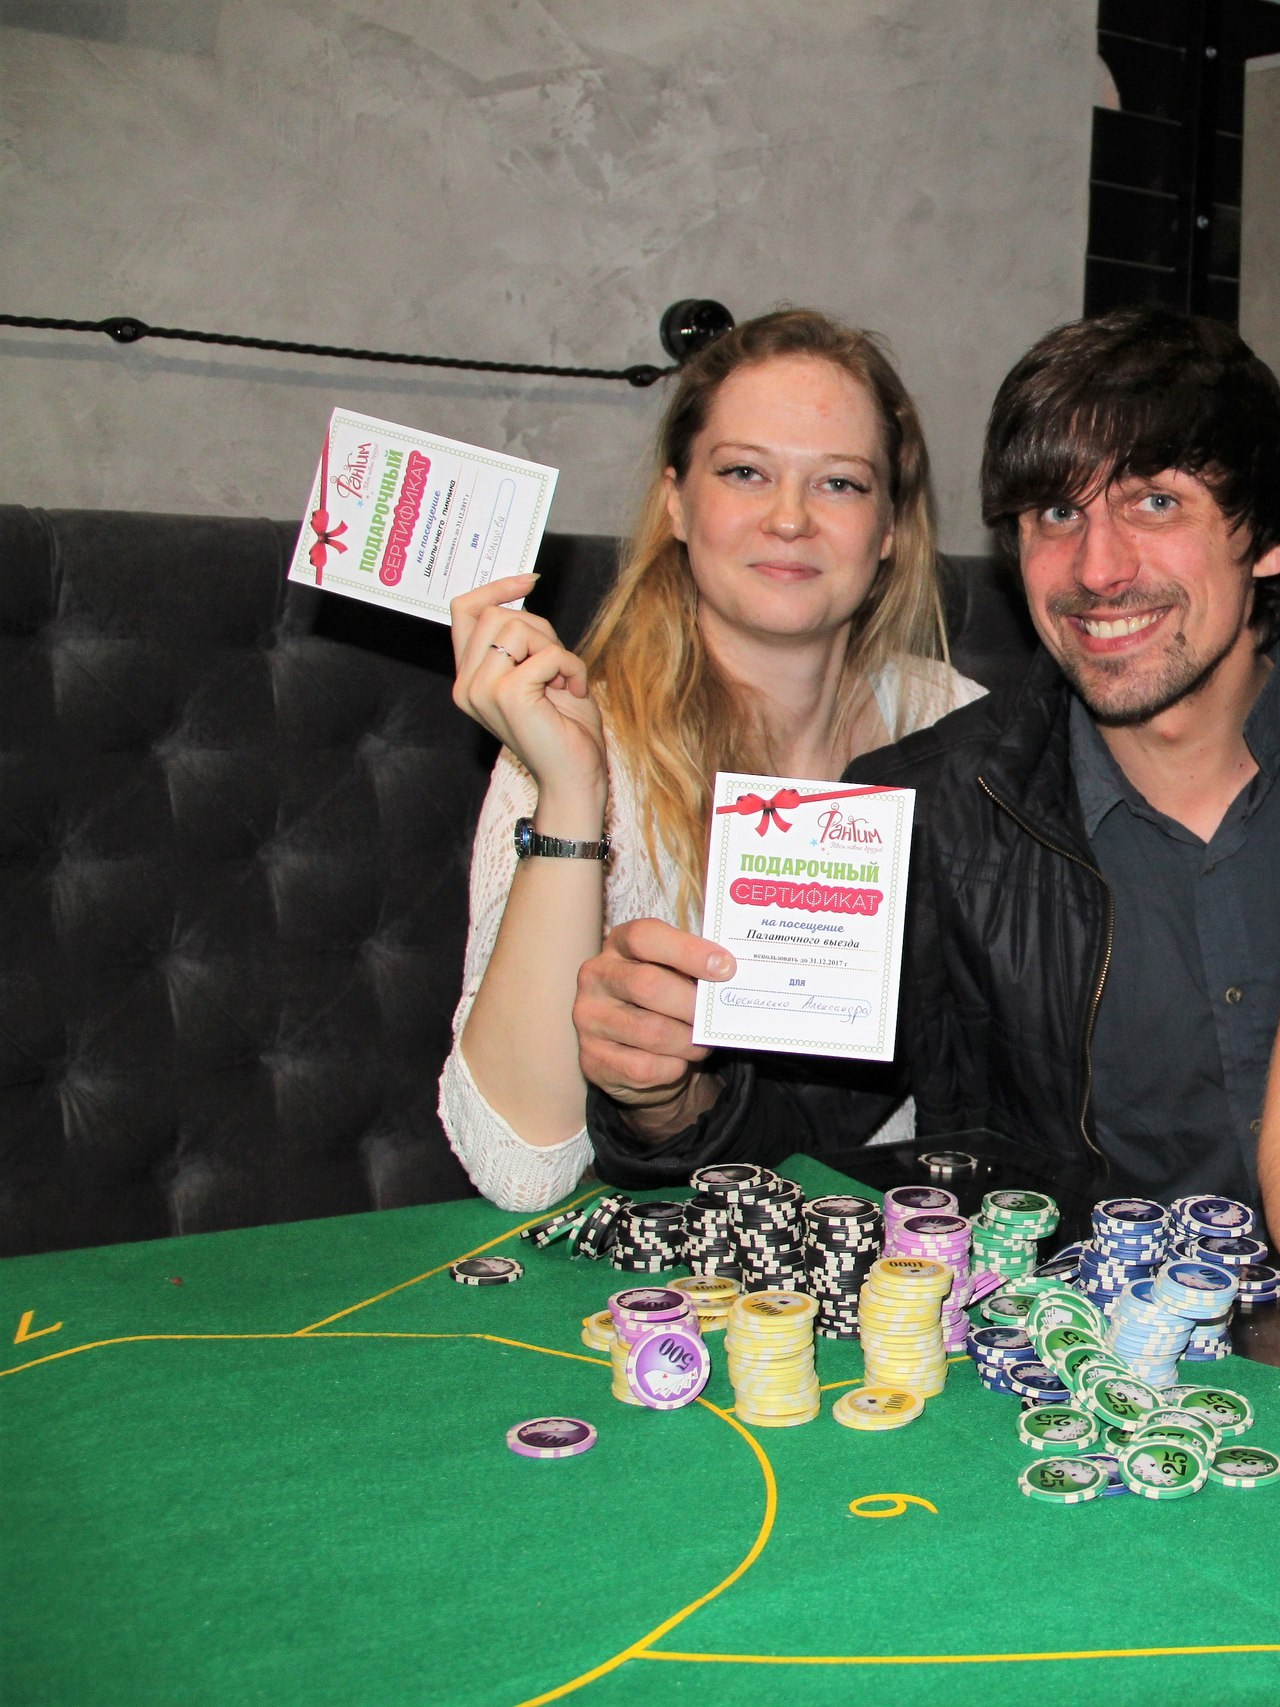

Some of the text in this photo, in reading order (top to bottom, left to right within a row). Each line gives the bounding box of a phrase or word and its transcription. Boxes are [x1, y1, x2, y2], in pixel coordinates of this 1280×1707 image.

[359, 449, 404, 574] ПОДАРОЧНЫЙ
[382, 455, 427, 583] СЕРТИФИКАТ
[416, 489, 442, 564] на посещение
[424, 479, 456, 578] Шашлычного пикника
[470, 533, 480, 549] для
[740, 853, 880, 883] ПОДАРОЧНЫЙ
[735, 883, 878, 911] СЕРТИФИКАТ
[761, 918, 845, 933] на посещение
[746, 929, 860, 948] Палаточного выезда
[753, 953, 799, 963] использовать
[809, 957, 844, 966] 31.12.2017
[788, 978, 806, 987] для
[889, 1261, 925, 1269] 1000
[751, 1302, 783, 1316] 1000
[658, 1337, 695, 1371] 500
[884, 1393, 909, 1410] 1000
[1105, 1391, 1136, 1416] 25
[1201, 1392, 1238, 1414] 25
[1034, 1413, 1071, 1426] 25
[1161, 1451, 1188, 1476] 25
[1229, 1450, 1260, 1465] 25
[1039, 1469, 1065, 1488] 25
